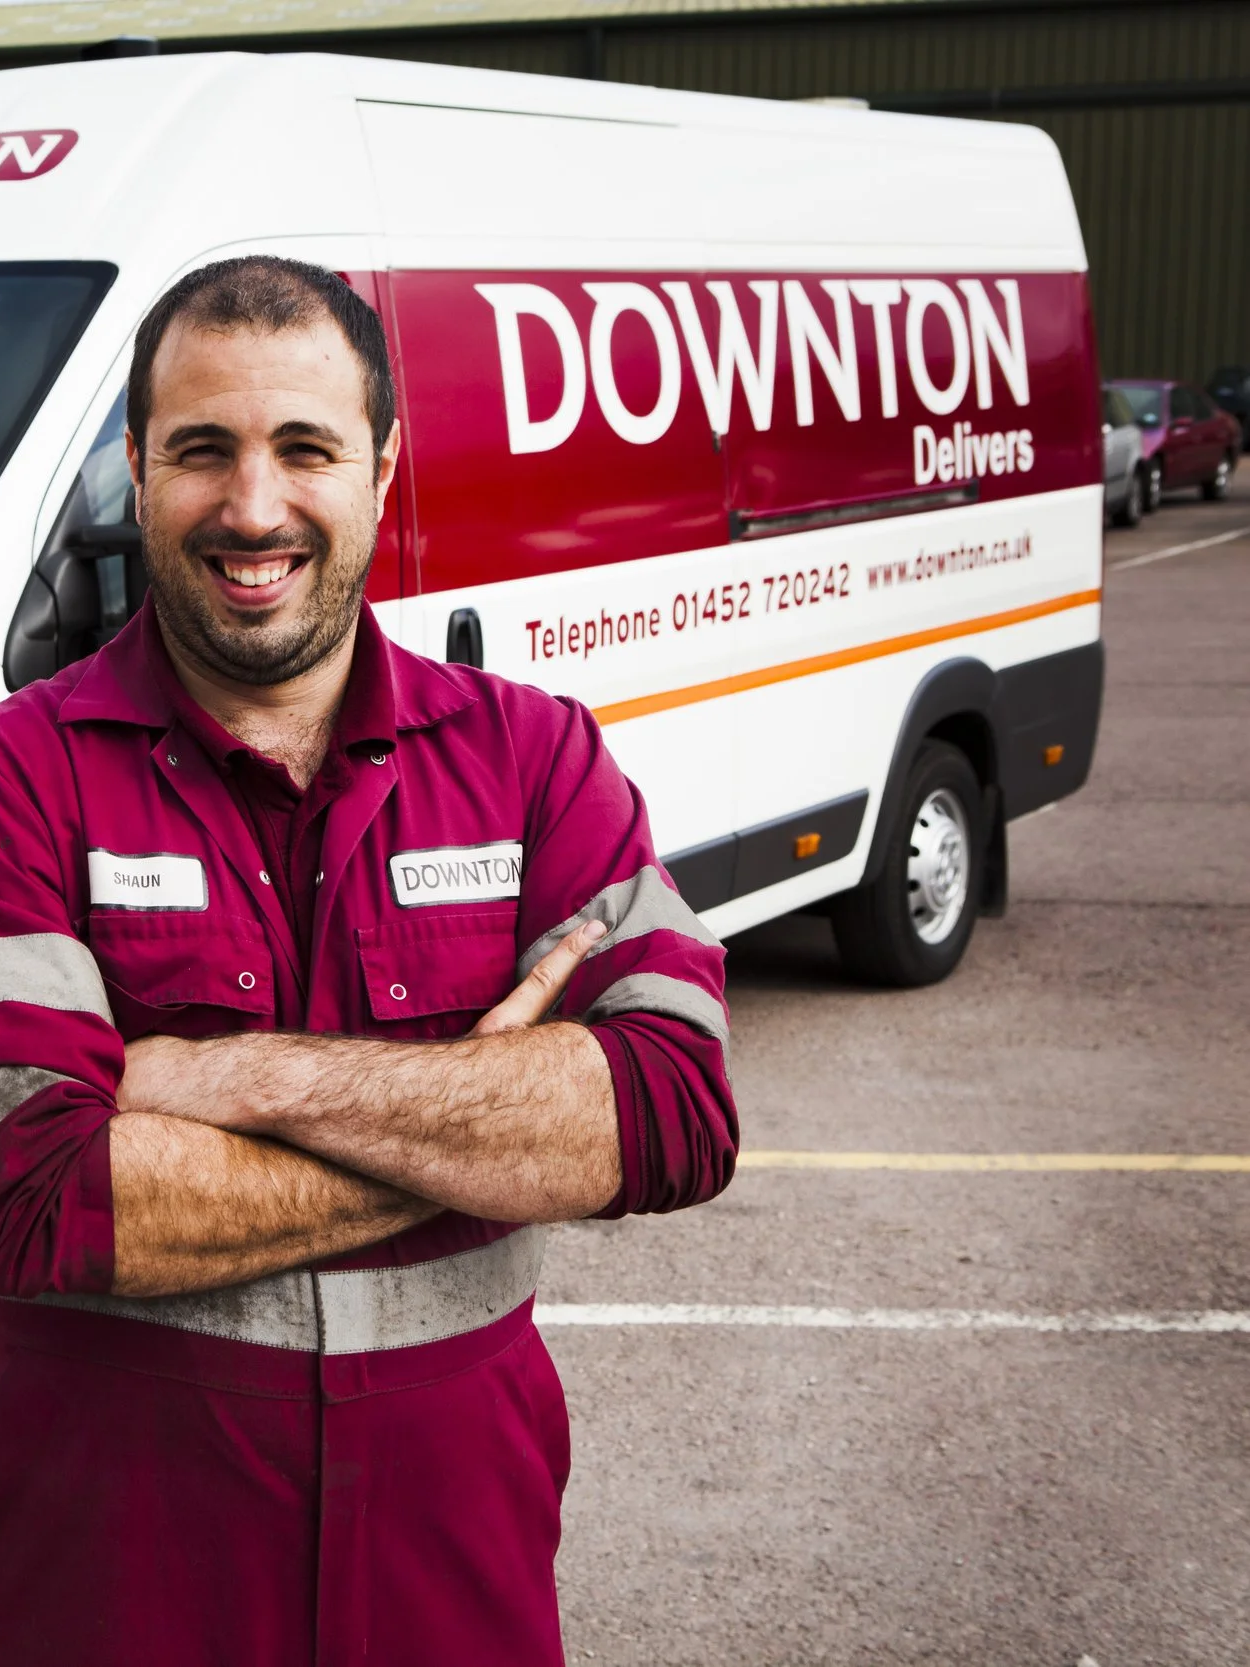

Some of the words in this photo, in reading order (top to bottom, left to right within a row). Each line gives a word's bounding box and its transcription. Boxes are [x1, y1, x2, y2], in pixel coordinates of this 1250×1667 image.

[474, 278, 1031, 455] DOWNTON
[913, 420, 1035, 486] Delivers
[525, 608, 661, 661] Telephone
[672, 581, 751, 632] 01452
[762, 563, 850, 613] 720242
[866, 533, 1032, 591] www.downton.co.uk
[113, 871, 161, 888] SHAUN
[400, 856, 522, 892] DOWNTON
